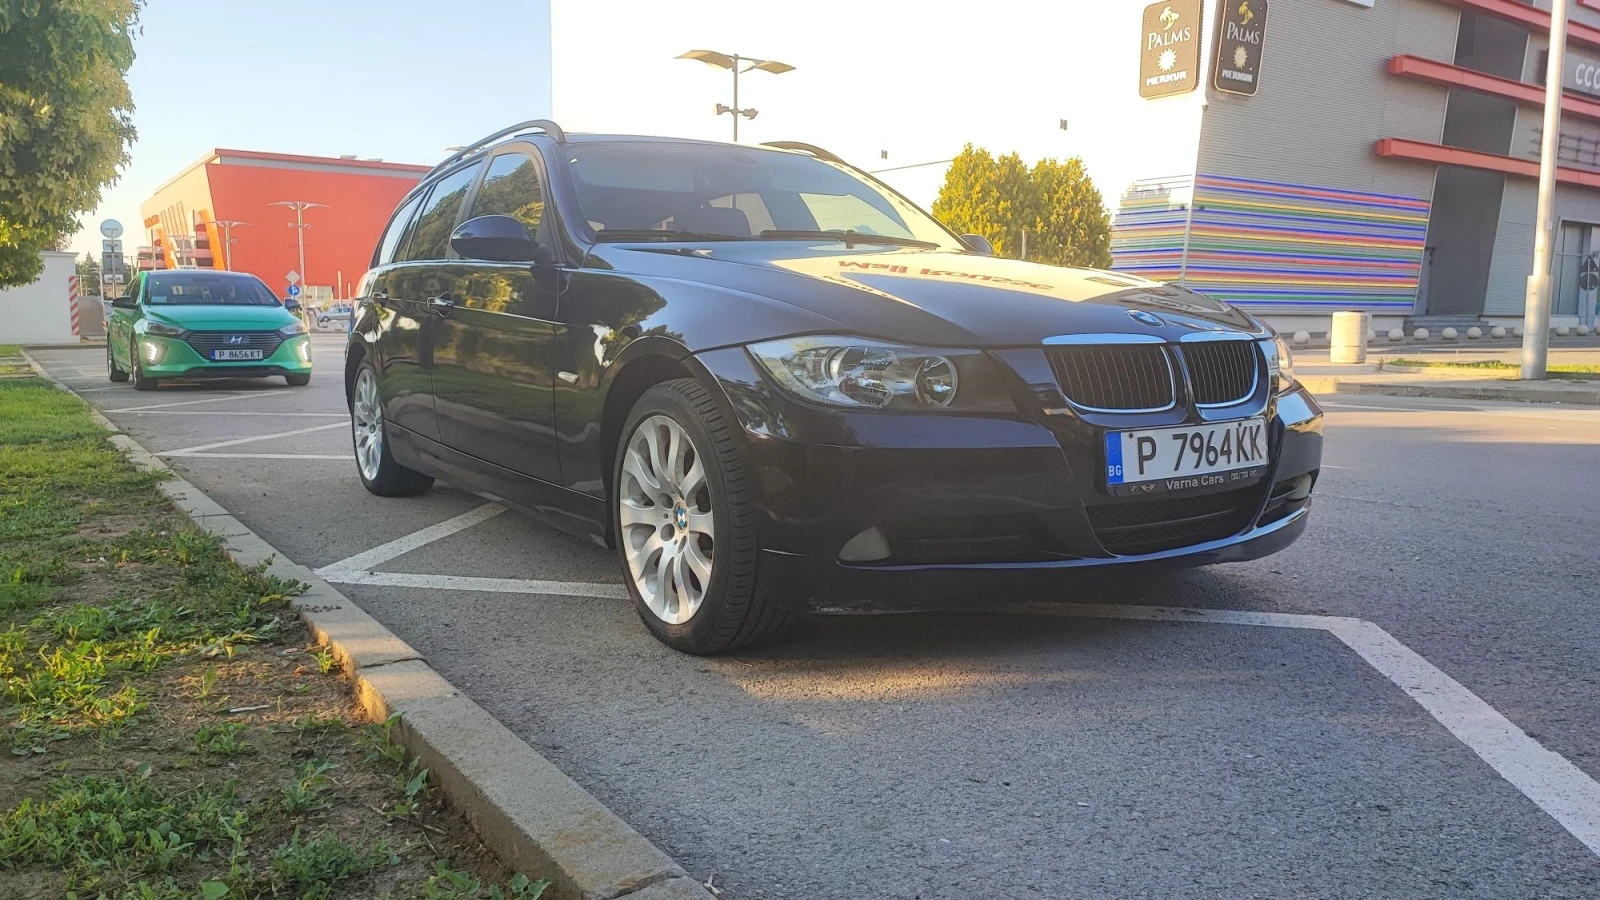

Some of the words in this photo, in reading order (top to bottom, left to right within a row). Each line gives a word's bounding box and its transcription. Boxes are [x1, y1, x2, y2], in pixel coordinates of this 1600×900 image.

[1147, 26, 1191, 51] PALMS
[1226, 21, 1260, 45] PALMS
[1146, 71, 1187, 86] MERKUR
[219, 351, 225, 359] P
[229, 350, 261, 359] 8656KT
[1137, 436, 1156, 475] P
[1172, 424, 1263, 472] 7964KK
[1108, 464, 1122, 477] BG
[1165, 478, 1198, 490] Varna
[1201, 475, 1225, 486] Cars
